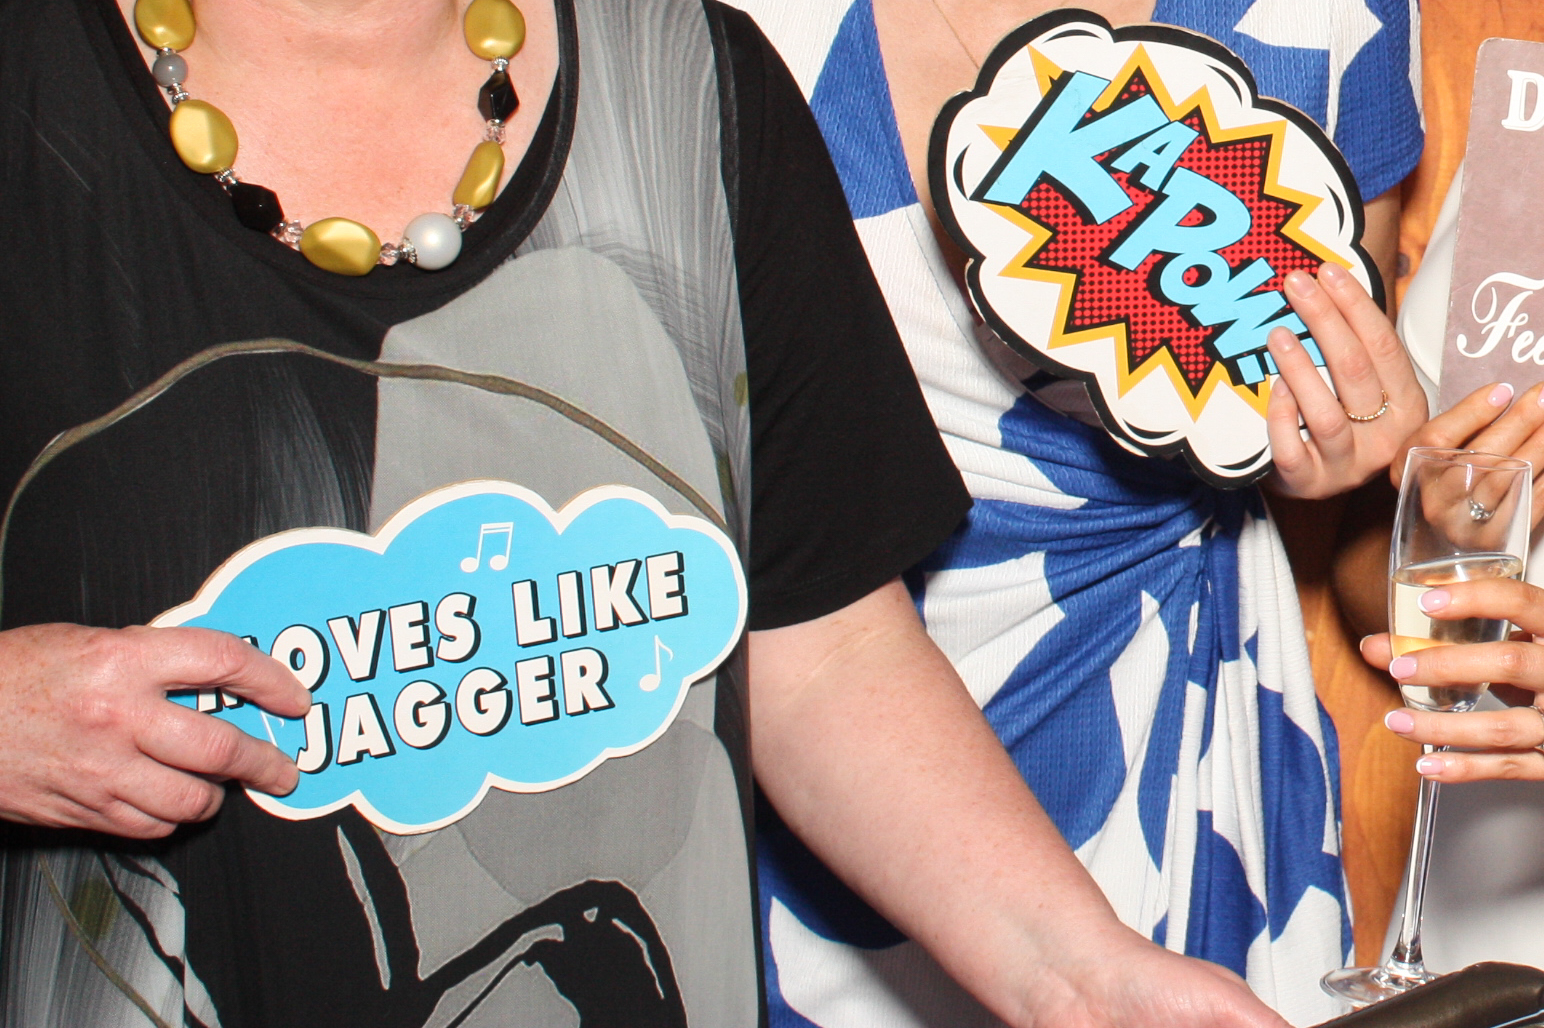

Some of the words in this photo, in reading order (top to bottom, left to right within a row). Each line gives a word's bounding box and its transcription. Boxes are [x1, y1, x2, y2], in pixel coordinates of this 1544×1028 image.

[196, 592, 480, 714] OVES
[511, 550, 689, 648] LIKE
[297, 647, 616, 774] JAGGER
